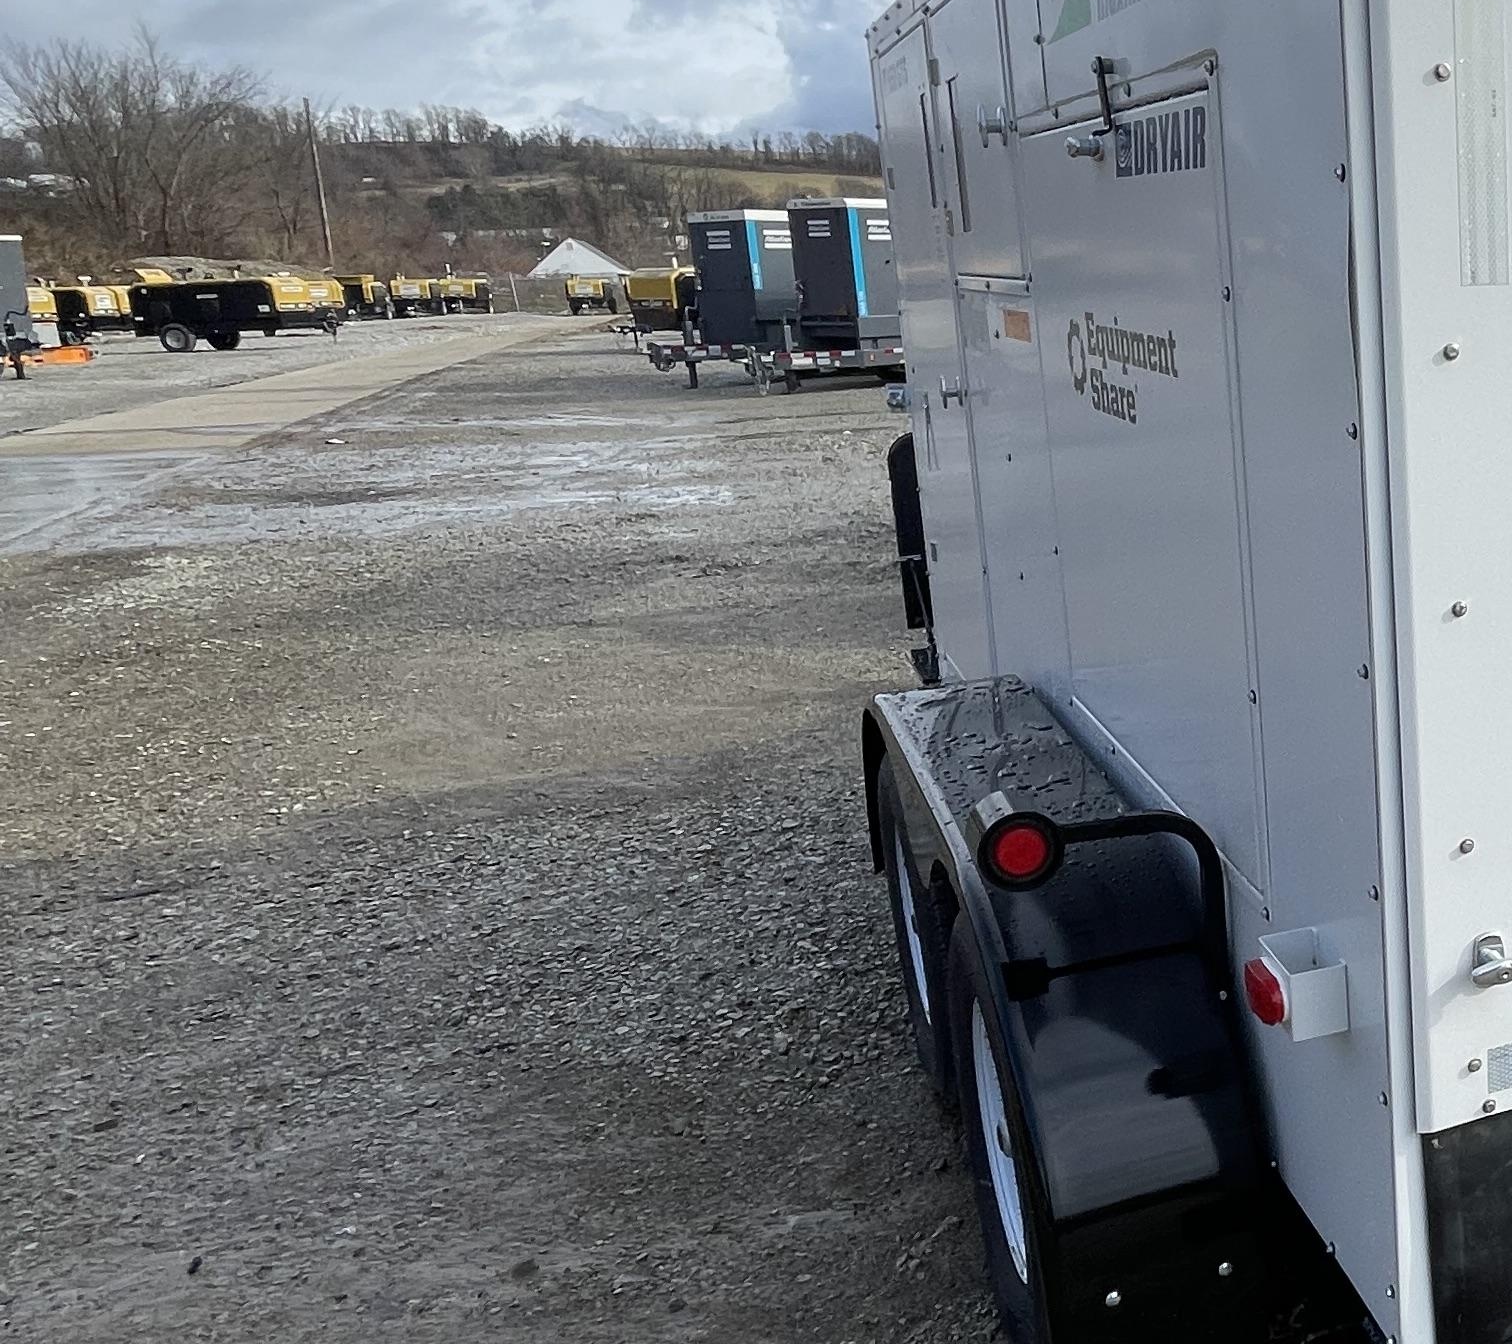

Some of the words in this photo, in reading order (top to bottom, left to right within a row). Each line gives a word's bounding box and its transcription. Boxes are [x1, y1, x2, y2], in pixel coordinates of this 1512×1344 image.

[1133, 106, 1207, 177] DRYAIR
[1084, 311, 1179, 380] Equipment
[1089, 367, 1138, 425] Share
